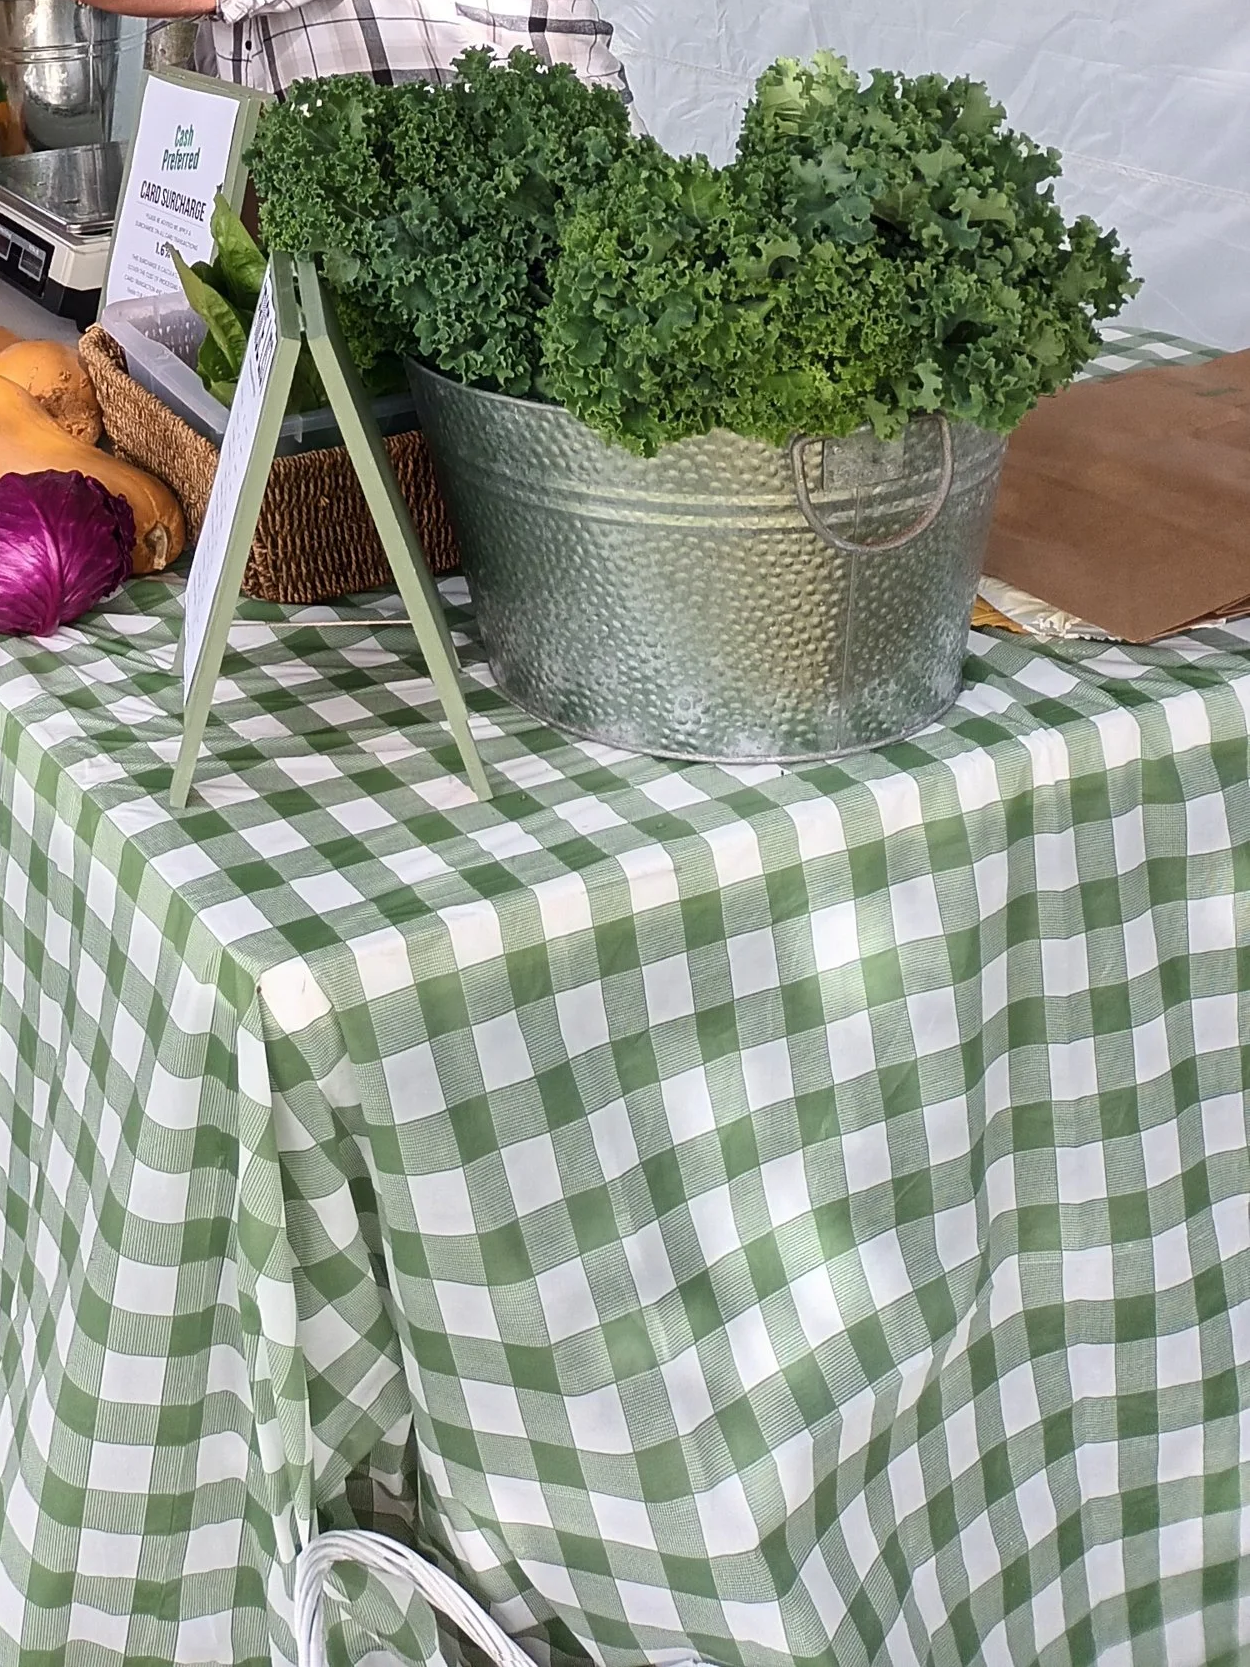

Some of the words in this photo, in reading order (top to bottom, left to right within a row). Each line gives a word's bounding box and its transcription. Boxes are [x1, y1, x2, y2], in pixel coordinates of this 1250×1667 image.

[174, 124, 194, 148] Cash
[161, 147, 201, 172] Preferred
[140, 180, 162, 204] CARD
[160, 188, 207, 222] SURCHARGE
